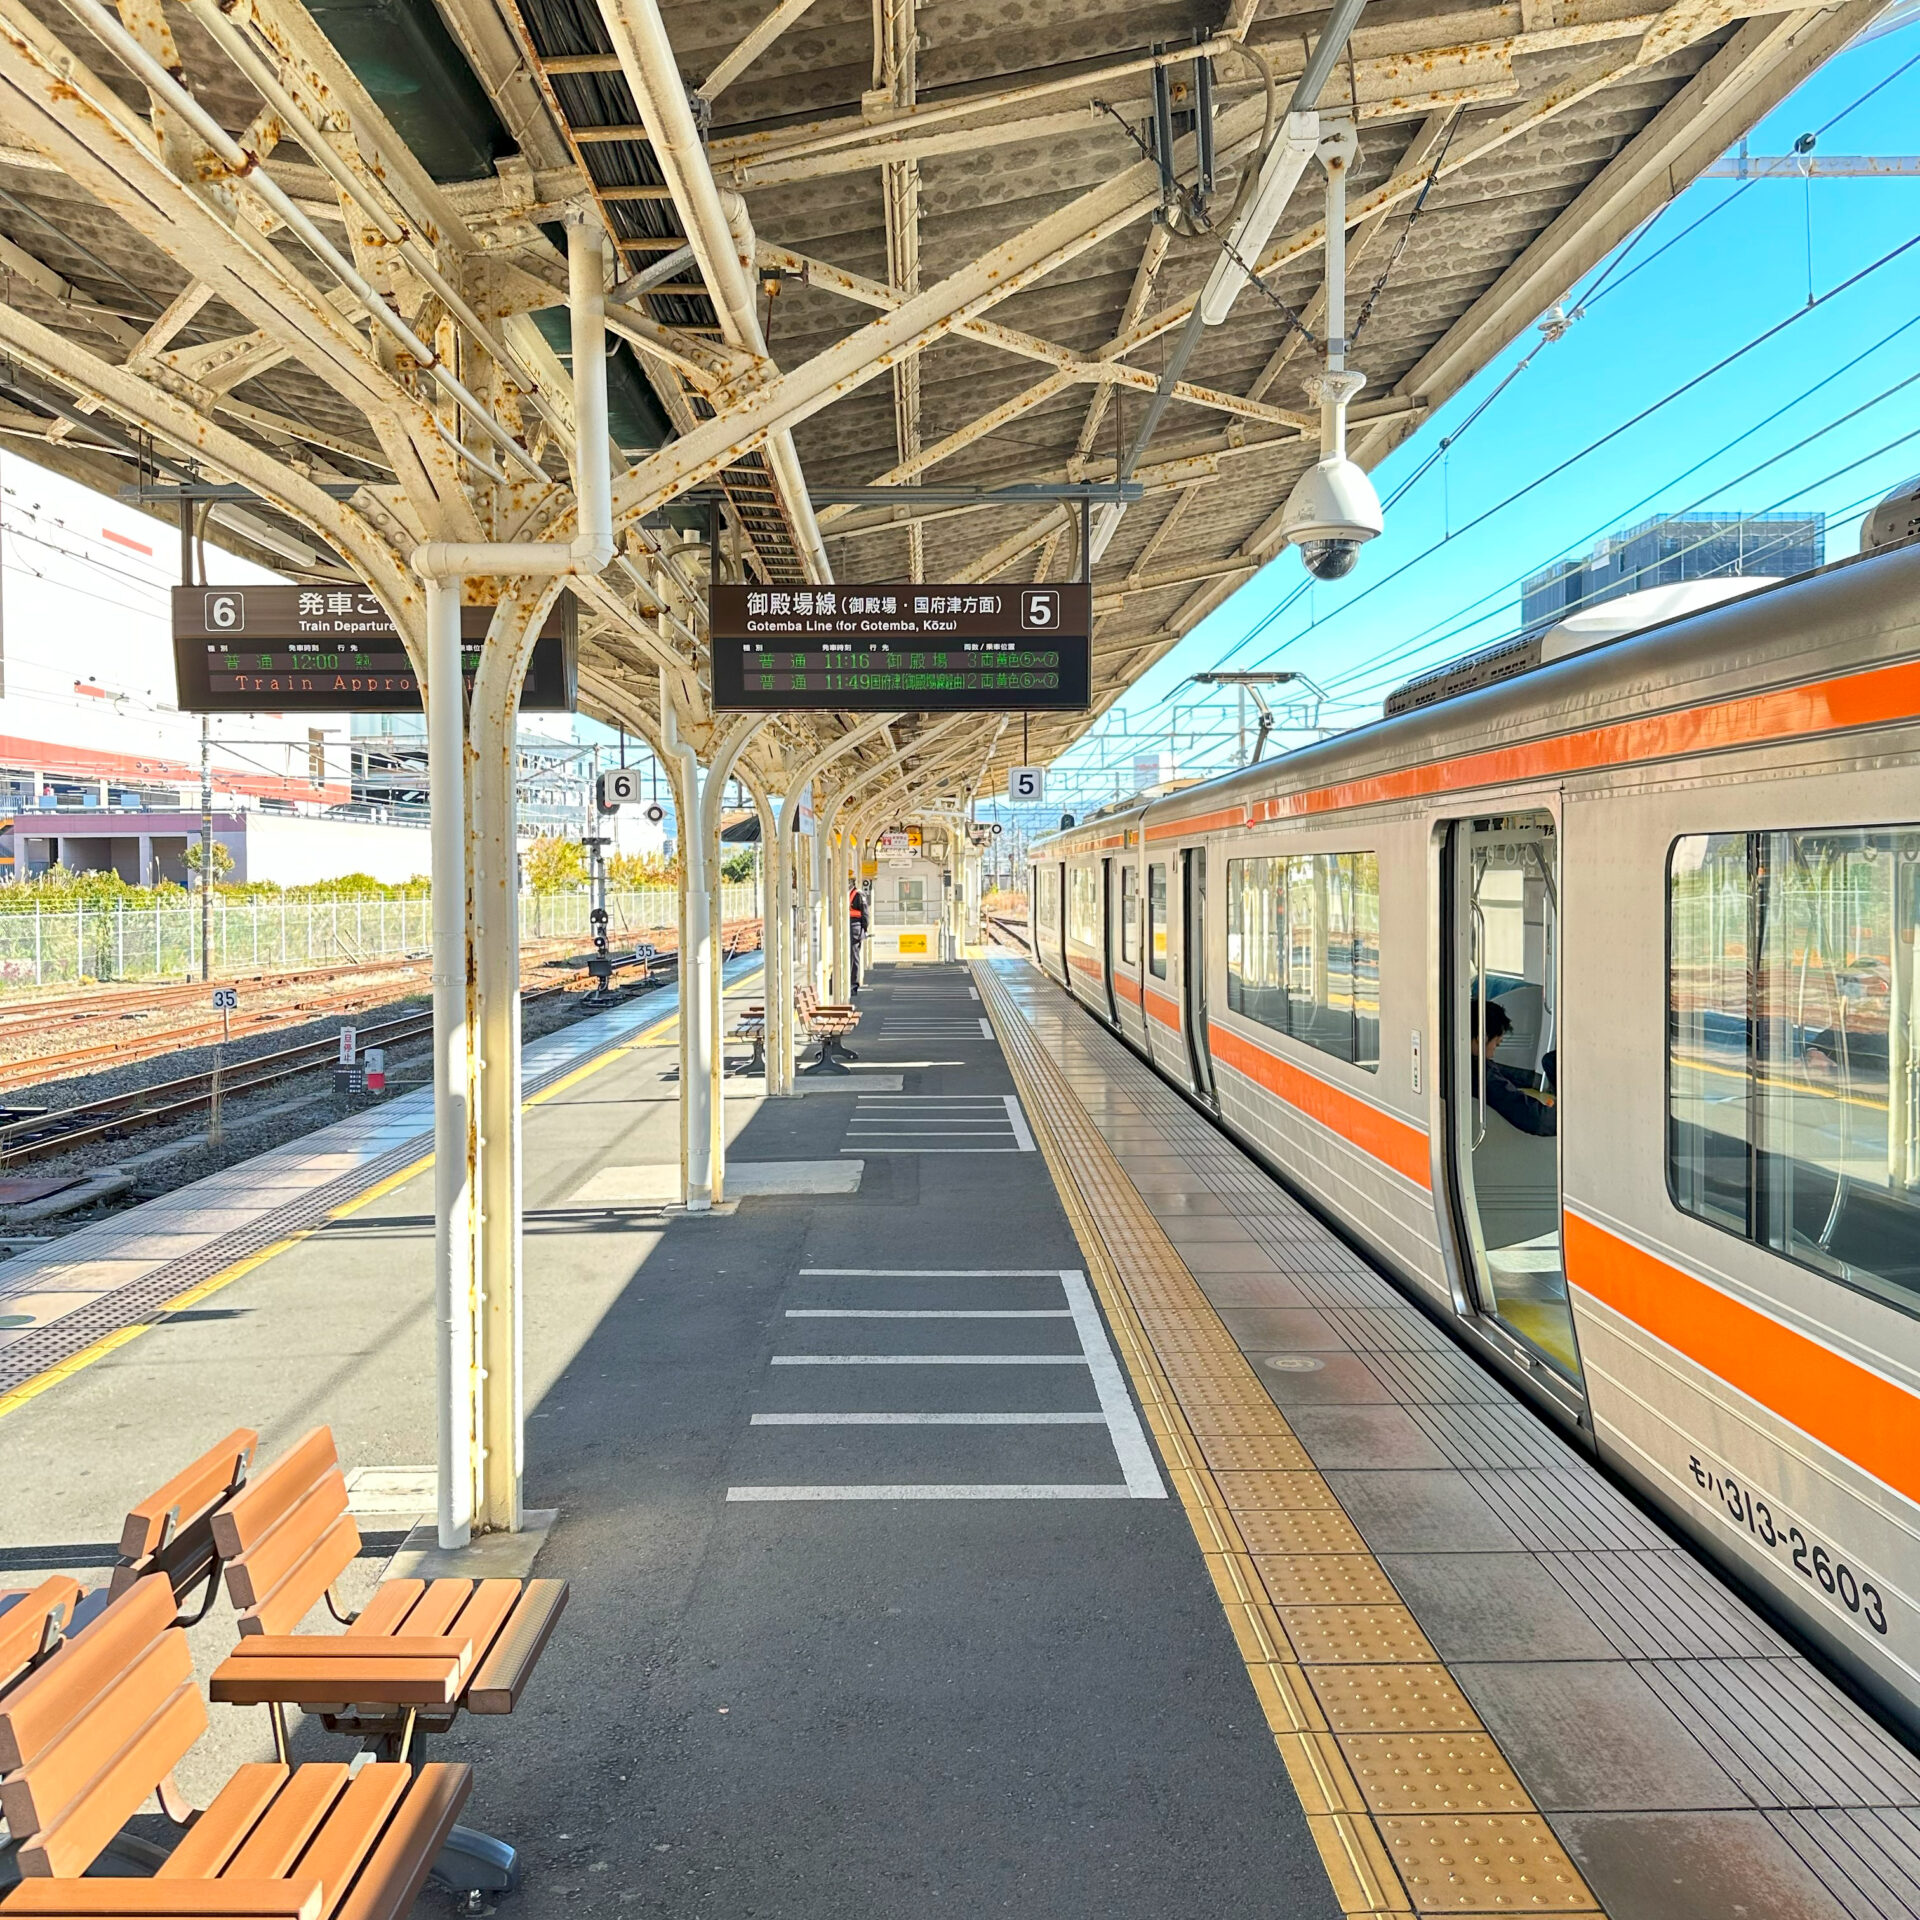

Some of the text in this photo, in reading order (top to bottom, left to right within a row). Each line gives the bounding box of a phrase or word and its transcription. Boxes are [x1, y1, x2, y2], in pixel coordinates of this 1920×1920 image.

[213, 597, 236, 627] 6
[299, 592, 388, 616] 発車ご
[1029, 596, 1051, 625] 5
[299, 621, 330, 631] Train
[747, 620, 802, 631] Gotemba
[806, 620, 833, 631] Line
[836, 620, 857, 631] (for
[860, 620, 919, 632] Gotemba,
[292, 654, 338, 669] 12:00
[825, 653, 870, 669] 11:16
[235, 675, 313, 690] Train
[825, 674, 870, 690] 11:49
[615, 776, 631, 797] 6
[1018, 774, 1034, 794] 5
[638, 945, 652, 957] 35
[214, 991, 235, 1007] 35
[1689, 1455, 1888, 1635] モハ313-2603
